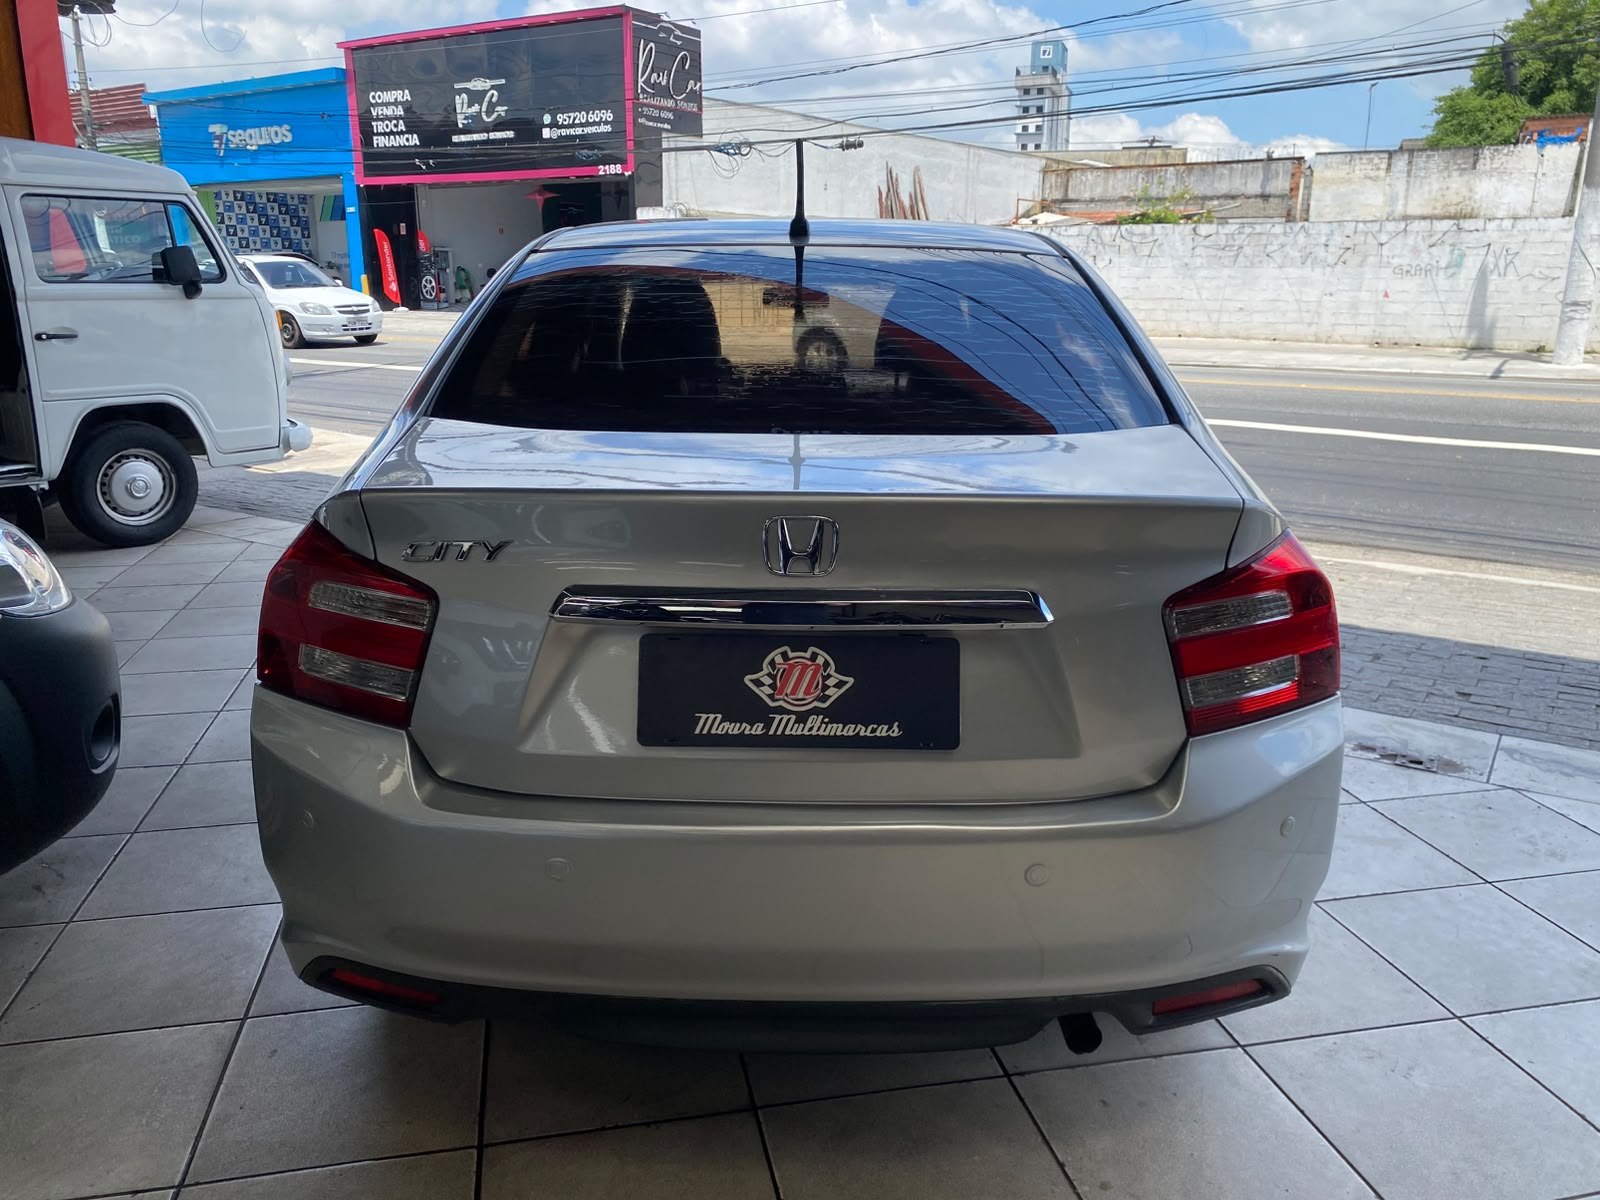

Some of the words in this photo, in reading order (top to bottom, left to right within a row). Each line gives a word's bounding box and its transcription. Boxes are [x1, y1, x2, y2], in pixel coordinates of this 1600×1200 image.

[369, 89, 412, 103] COMPRA
[370, 105, 405, 118] VENDA
[556, 111, 587, 125] 95720
[587, 109, 614, 123] 6096
[371, 119, 406, 133] TROCA
[372, 133, 420, 148] FINANCIA
[597, 163, 623, 175] 2188
[382, 241, 395, 282] Santander
[401, 540, 514, 562] CITY
[694, 713, 766, 735] Moura
[768, 714, 903, 737] Multimarcas
